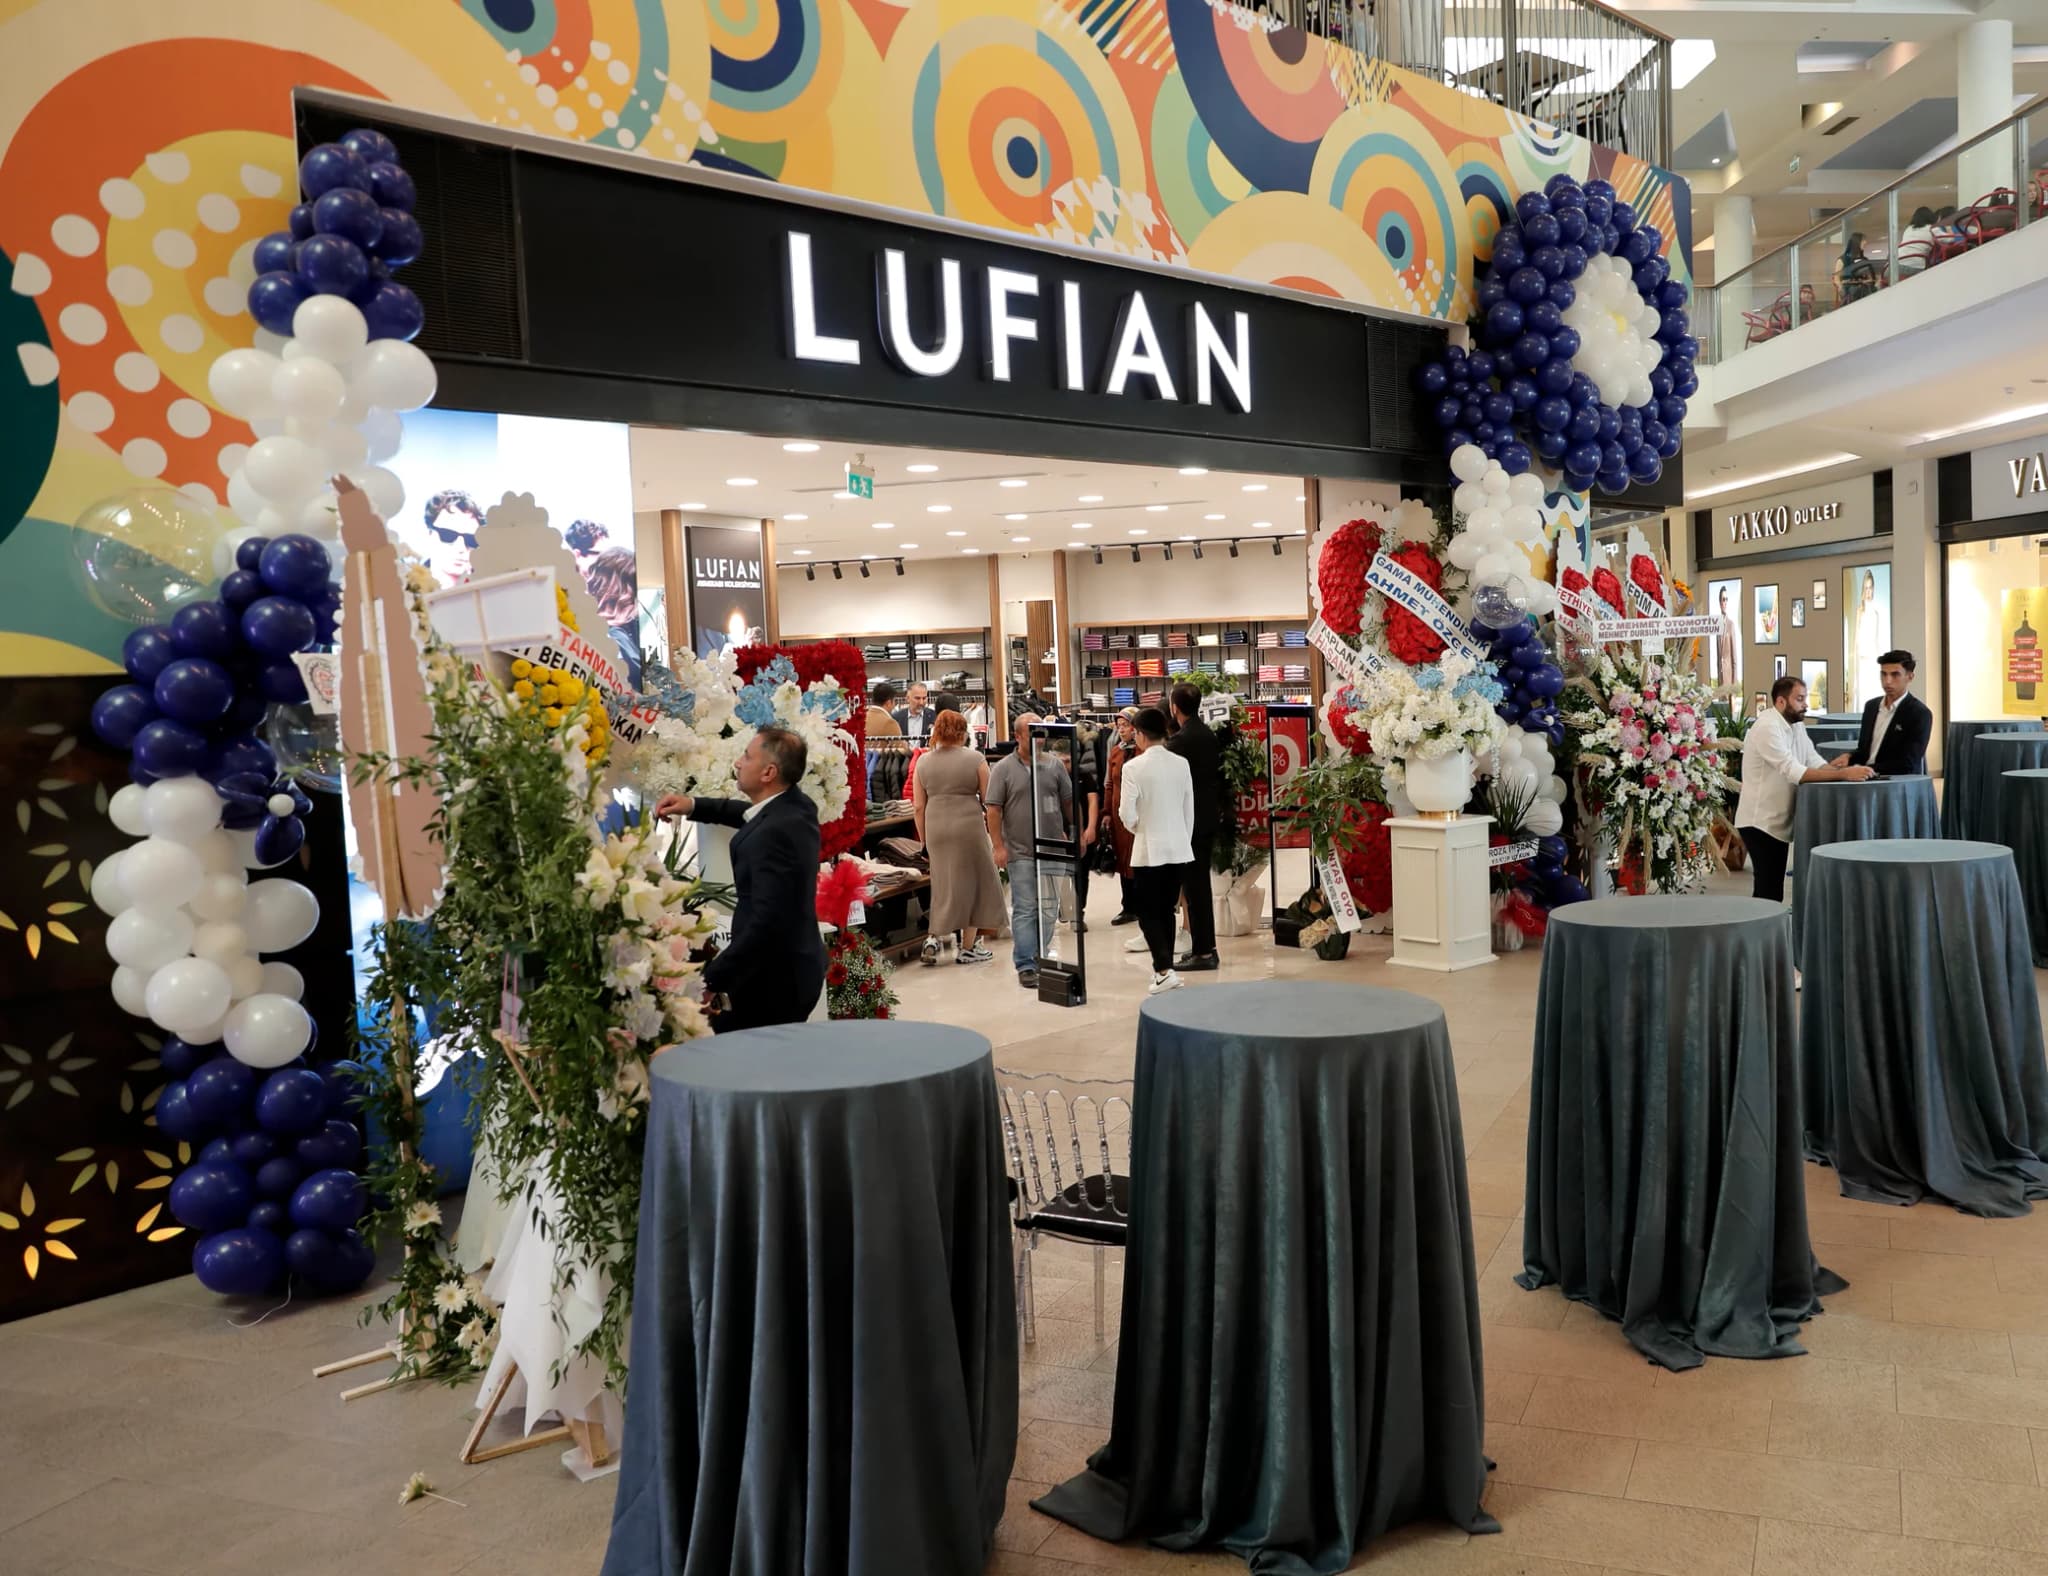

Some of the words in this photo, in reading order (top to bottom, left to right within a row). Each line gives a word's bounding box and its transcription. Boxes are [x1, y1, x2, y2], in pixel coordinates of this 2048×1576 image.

[786, 231, 1252, 414] LUFIAN
[1729, 505, 1789, 543] VAKKO
[1794, 502, 1841, 525] OUTLET
[695, 558, 760, 579] LUFIAN
[1376, 556, 1412, 585] GAMA
[1367, 572, 1430, 616] AHMET
[1598, 630, 1628, 639] MEHMET
[1690, 625, 1720, 634] DURSUN
[1616, 620, 1661, 630] MEHMET
[1664, 617, 1719, 627] OTOMOTİV
[560, 628, 660, 724] TAHMAZOLU
[1340, 891, 1354, 917] GYO
